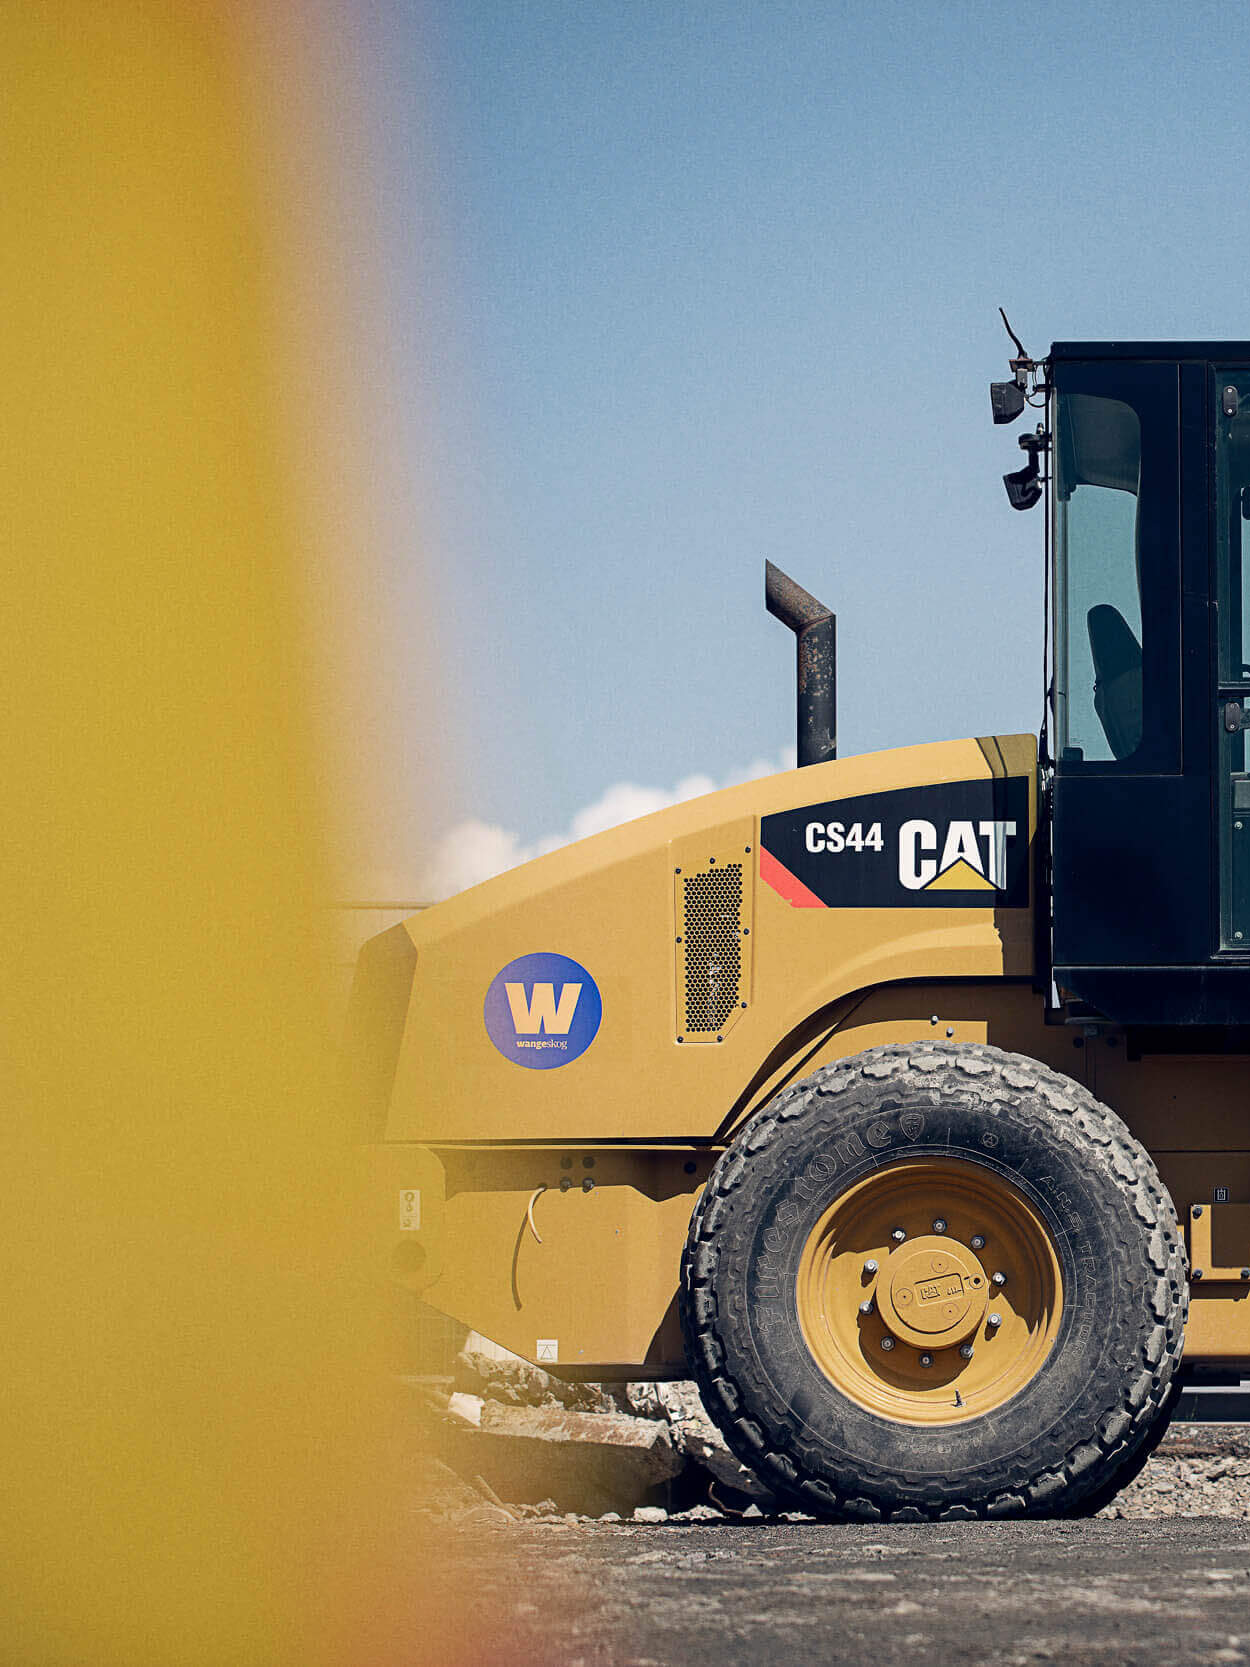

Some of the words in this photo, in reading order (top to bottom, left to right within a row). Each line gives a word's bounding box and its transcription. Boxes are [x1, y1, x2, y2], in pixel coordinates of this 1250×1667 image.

[805, 821, 884, 853] CS44
[899, 819, 1016, 890] CAT
[504, 983, 582, 1034] W
[516, 1039, 568, 1050] wangeskog
